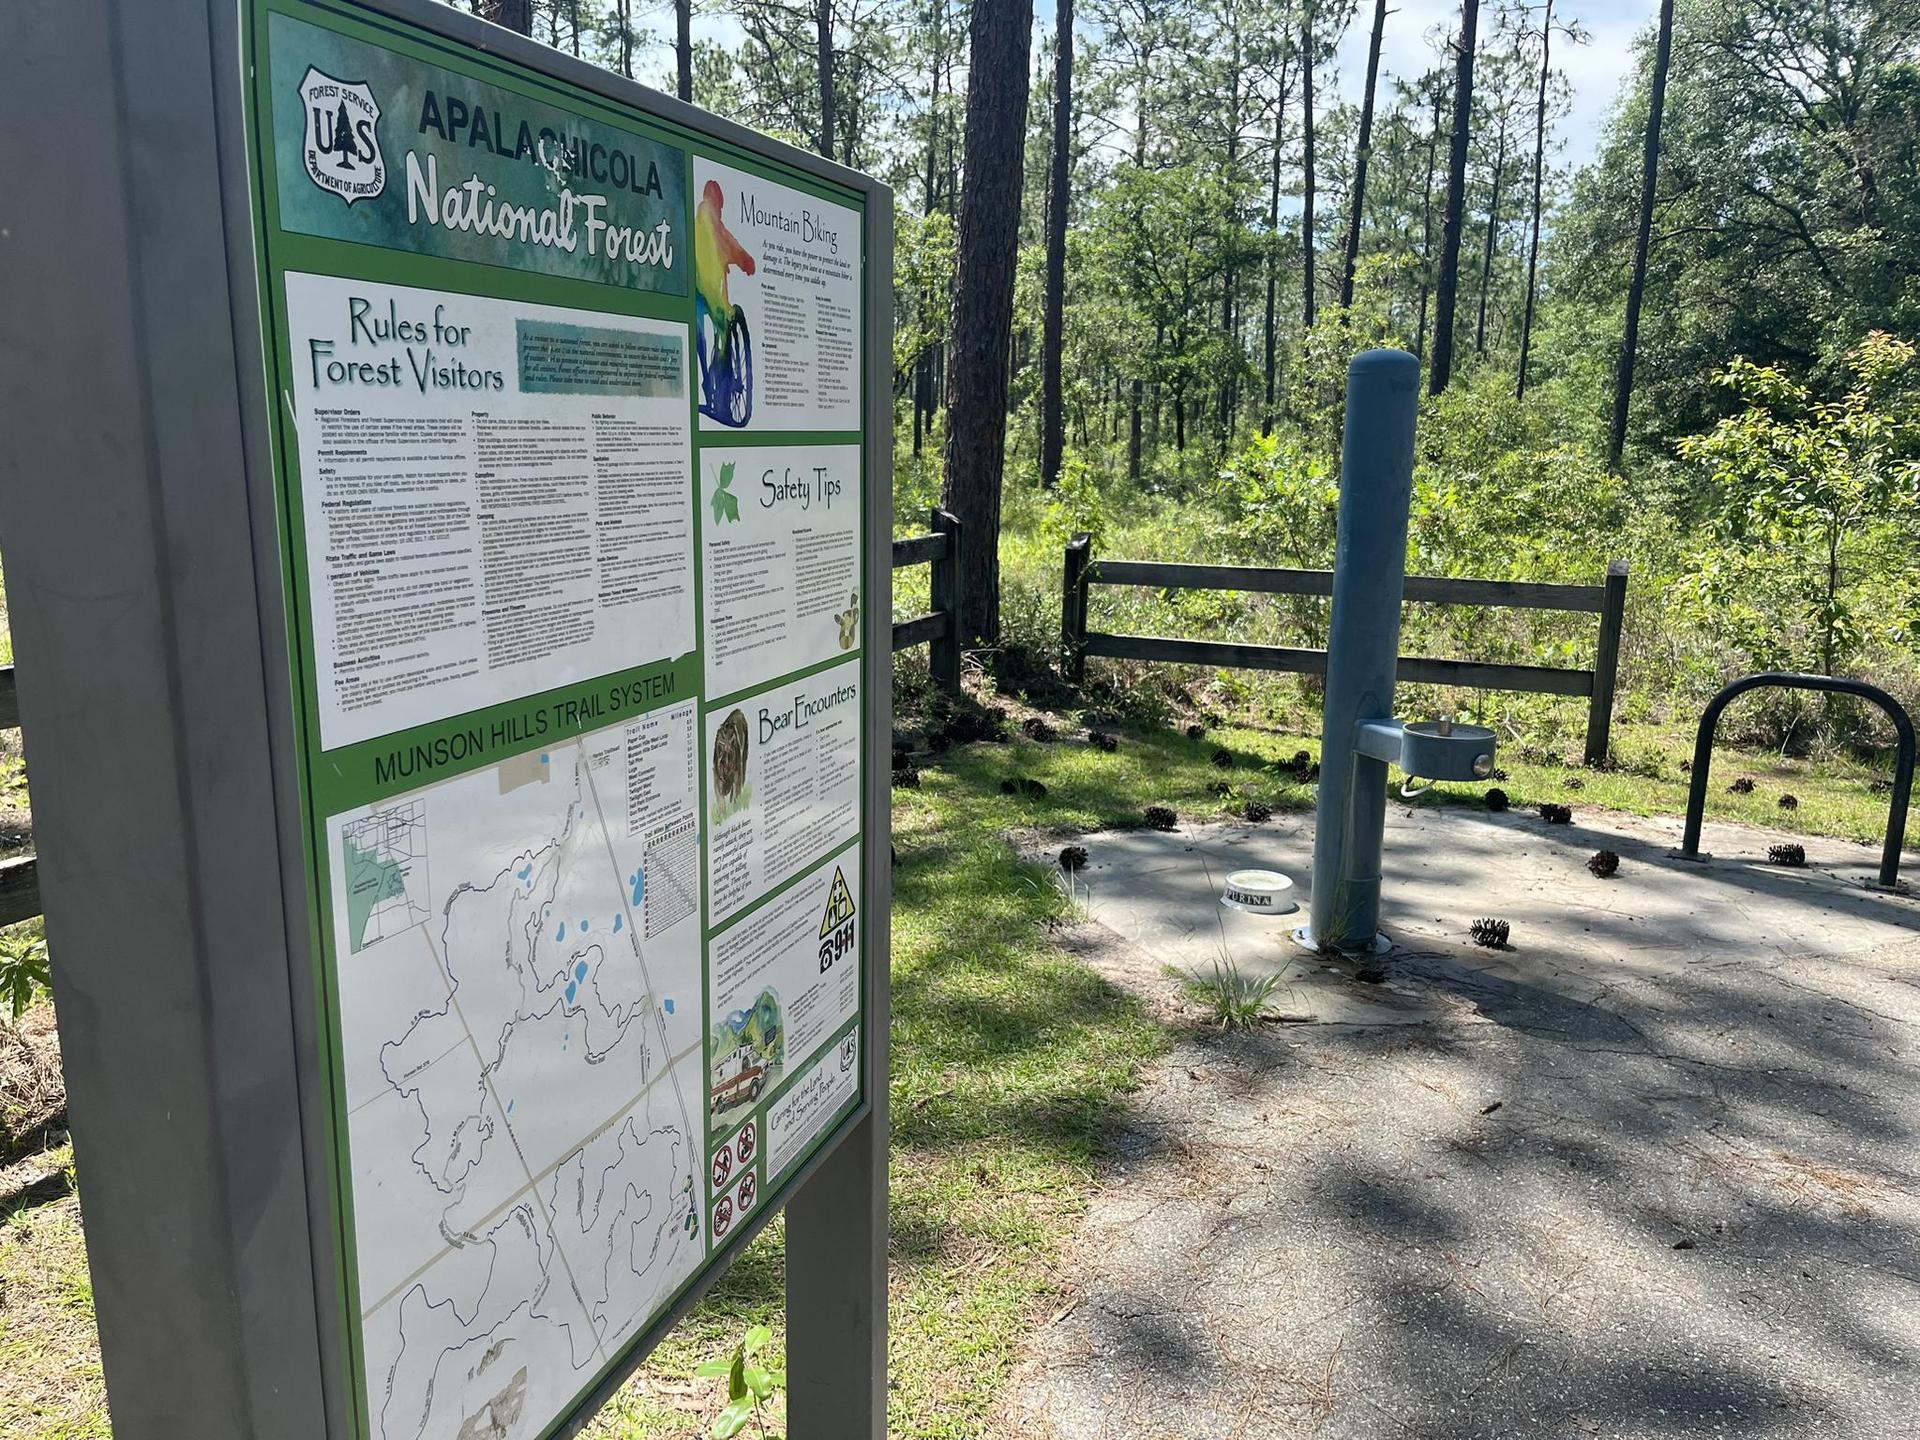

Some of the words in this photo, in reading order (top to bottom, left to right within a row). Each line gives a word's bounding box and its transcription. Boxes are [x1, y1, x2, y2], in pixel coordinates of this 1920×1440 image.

[309, 85, 339, 101] FOREST
[342, 88, 374, 119] SERVICE
[418, 90, 663, 200] APALACHICOLA
[308, 149, 343, 190] DEPARTMENT
[344, 181, 352, 193] OF
[352, 165, 381, 194] AGRICULTURE
[404, 149, 577, 253] National
[576, 193, 673, 269] Forest
[740, 191, 800, 235] Mountain
[802, 210, 838, 254] Biking
[349, 297, 428, 345] Rules
[433, 304, 471, 345] for
[308, 338, 402, 389] Forest
[406, 347, 504, 394] Visitors
[760, 467, 810, 510] Safety
[813, 467, 841, 509] Tips
[374, 728, 485, 786] MUNSON
[491, 708, 549, 749] HILLS
[552, 696, 605, 729] TRAIL
[609, 671, 675, 712] SYSTEM
[759, 707, 793, 745] Bear
[795, 683, 856, 729] Encounters
[1226, 888, 1271, 906] PURINA
[834, 918, 855, 961] 911
[771, 1104, 792, 1131] Caring
[809, 1067, 823, 1092] Land
[795, 1094, 819, 1121] Serving
